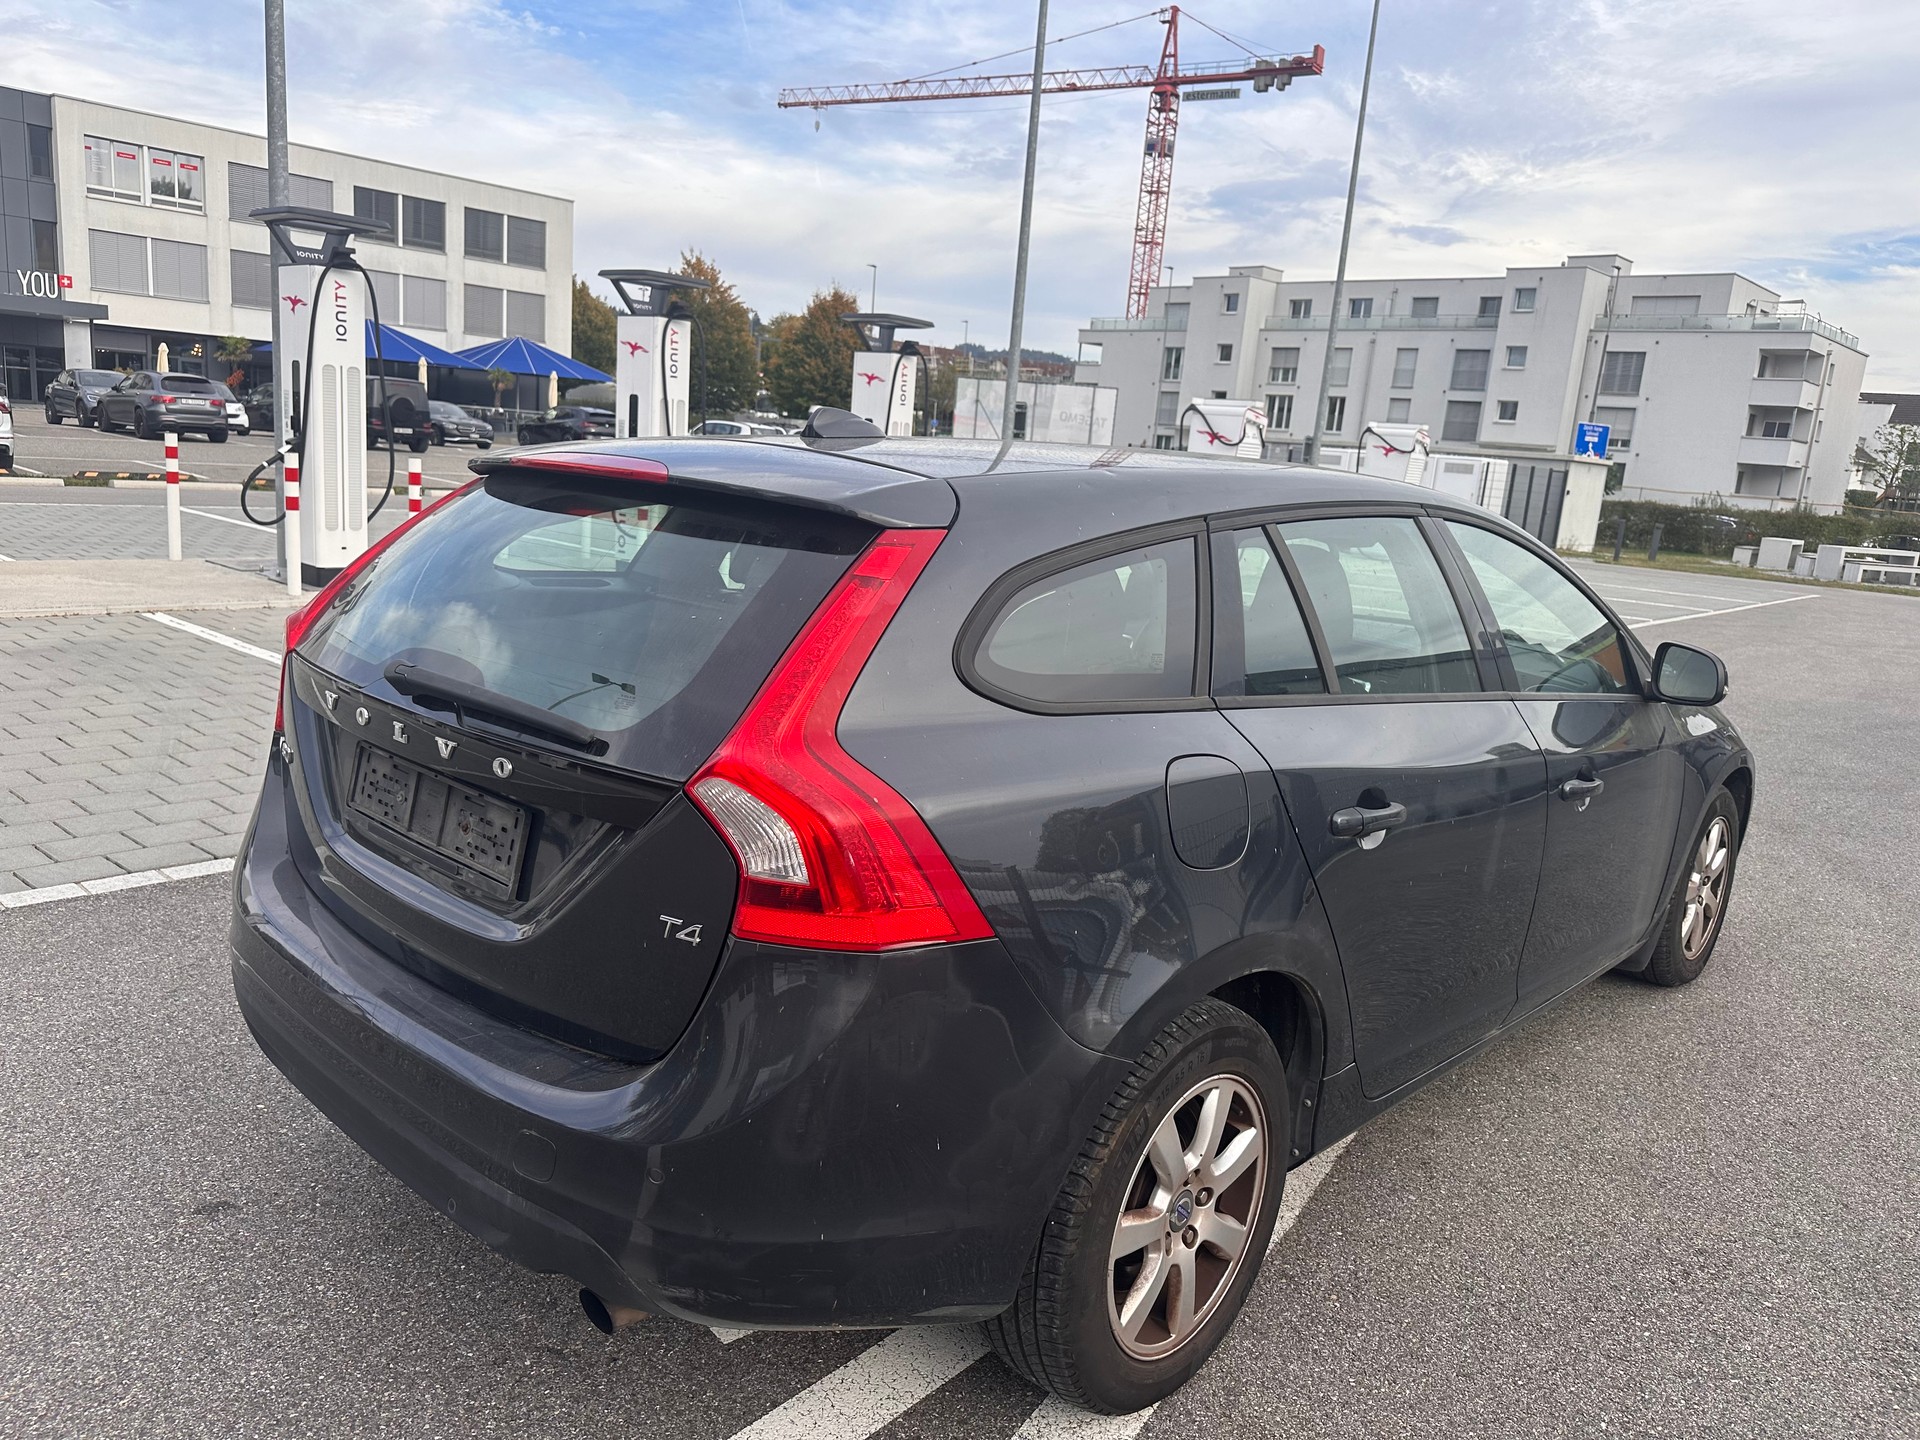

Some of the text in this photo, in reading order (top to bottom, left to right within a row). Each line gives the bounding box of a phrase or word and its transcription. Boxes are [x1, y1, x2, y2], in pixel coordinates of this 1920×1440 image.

[1186, 90, 1237, 100] estermann
[296, 250, 324, 260] IONITY
[17, 269, 59, 298] YOU
[335, 280, 347, 341] IONITY
[670, 328, 679, 379] IONITY
[900, 363, 908, 406] IONITY
[325, 690, 513, 779] VOLVO
[660, 914, 703, 946] T4
